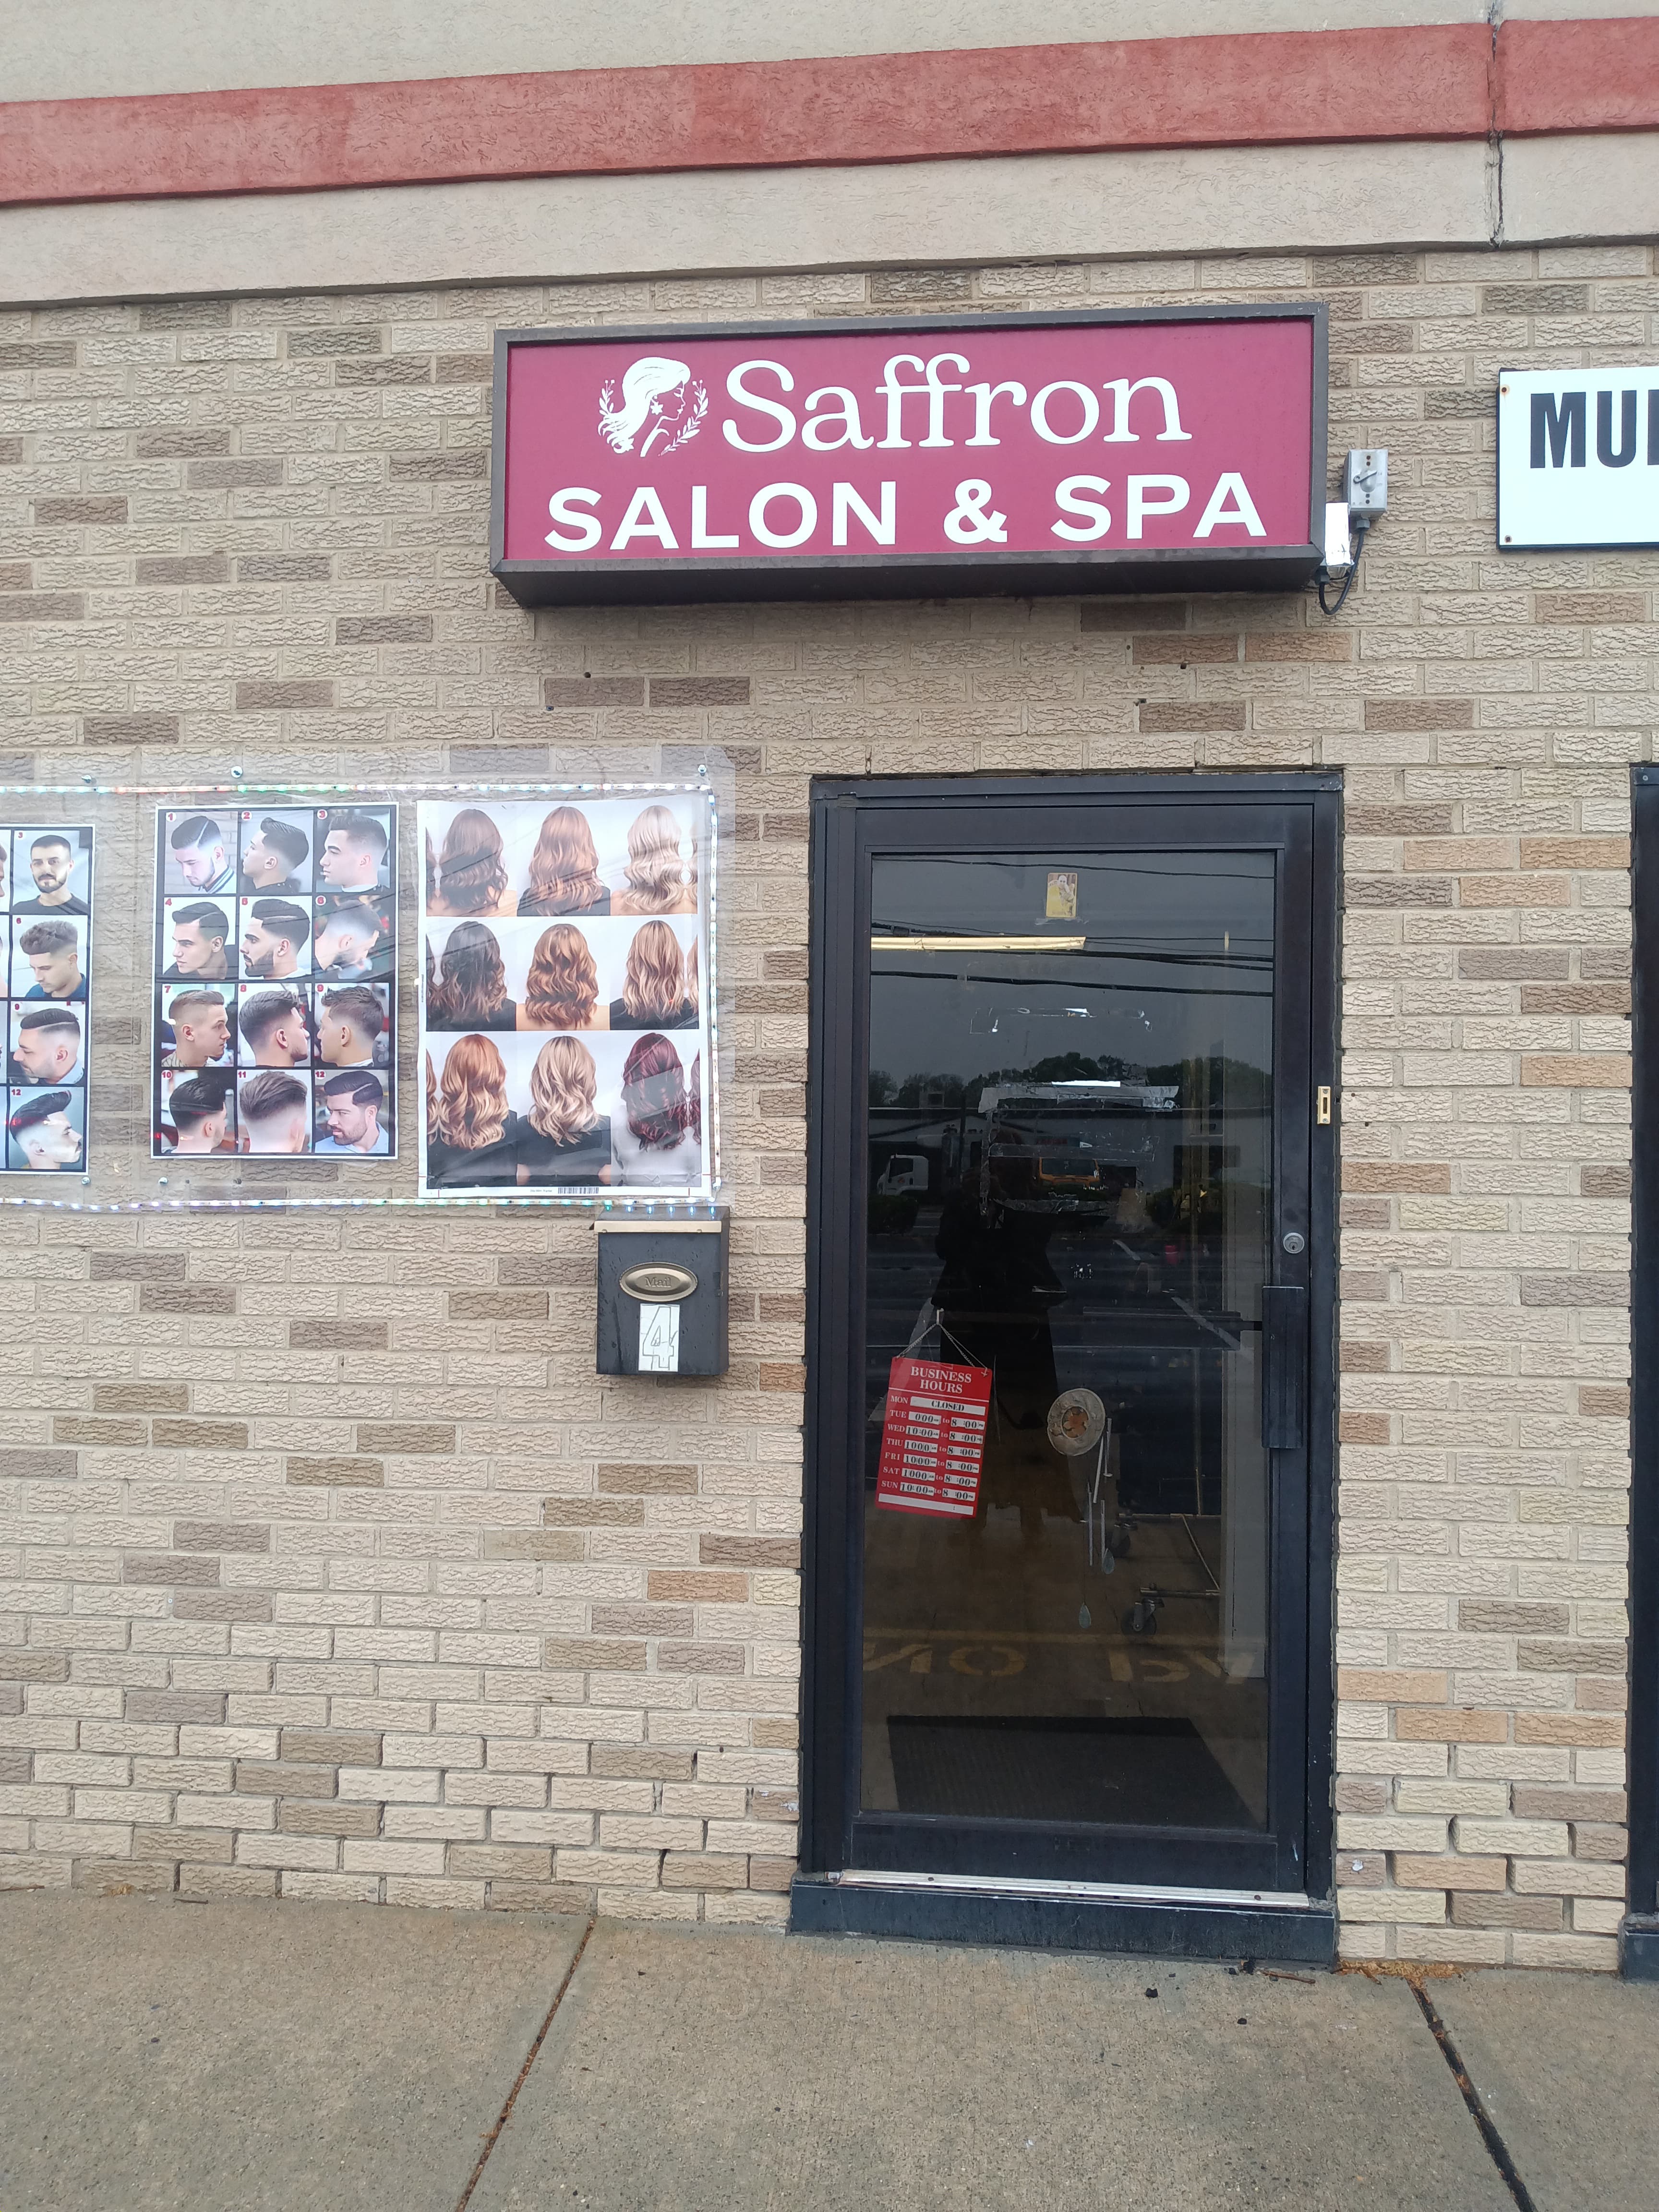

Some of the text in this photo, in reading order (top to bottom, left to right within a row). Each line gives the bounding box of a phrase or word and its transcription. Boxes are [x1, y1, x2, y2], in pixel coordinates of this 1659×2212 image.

[723, 353, 1192, 453] Saffron
[545, 473, 1267, 552] SALON & SPA
[644, 1276, 672, 1288] Mail
[642, 1306, 674, 1369] 4
[911, 1366, 972, 1383] BUSINESS
[920, 1379, 963, 1394] HOURS
[890, 1395, 964, 1411] MON CLOSED
[890, 1409, 907, 1419] TUE
[888, 1423, 905, 1432] WED
[886, 1438, 903, 1446] THU
[885, 1452, 900, 1460] FRI
[883, 1466, 900, 1475] SAT
[881, 1480, 899, 1489] SUN
